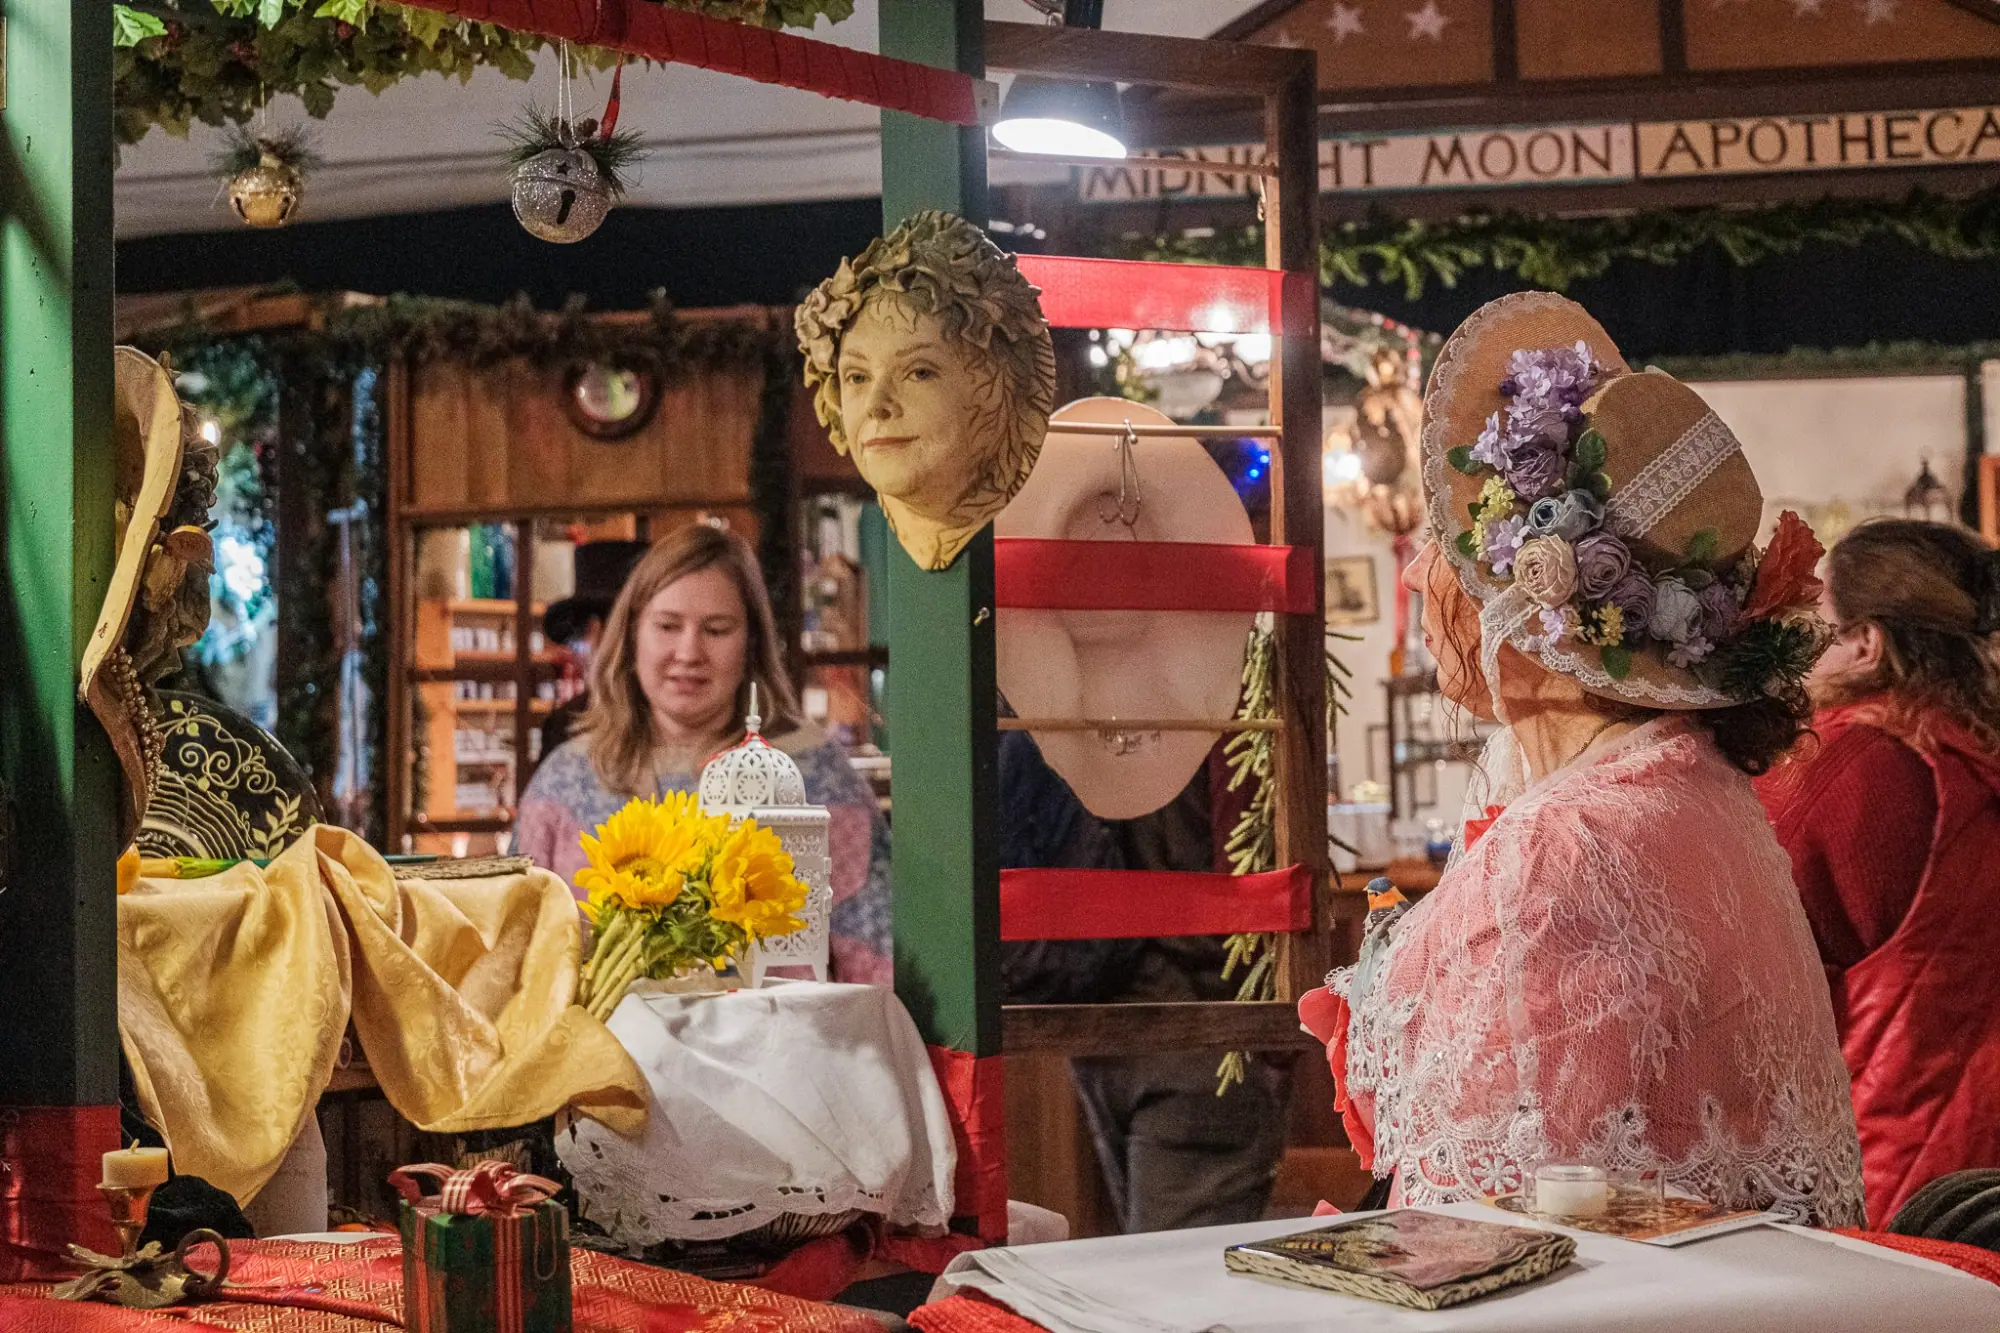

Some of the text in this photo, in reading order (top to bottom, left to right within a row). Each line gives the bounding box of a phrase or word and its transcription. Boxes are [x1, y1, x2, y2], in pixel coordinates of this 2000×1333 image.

[1086, 110, 2000, 198] MIDNIHT MOON APOTHECA
